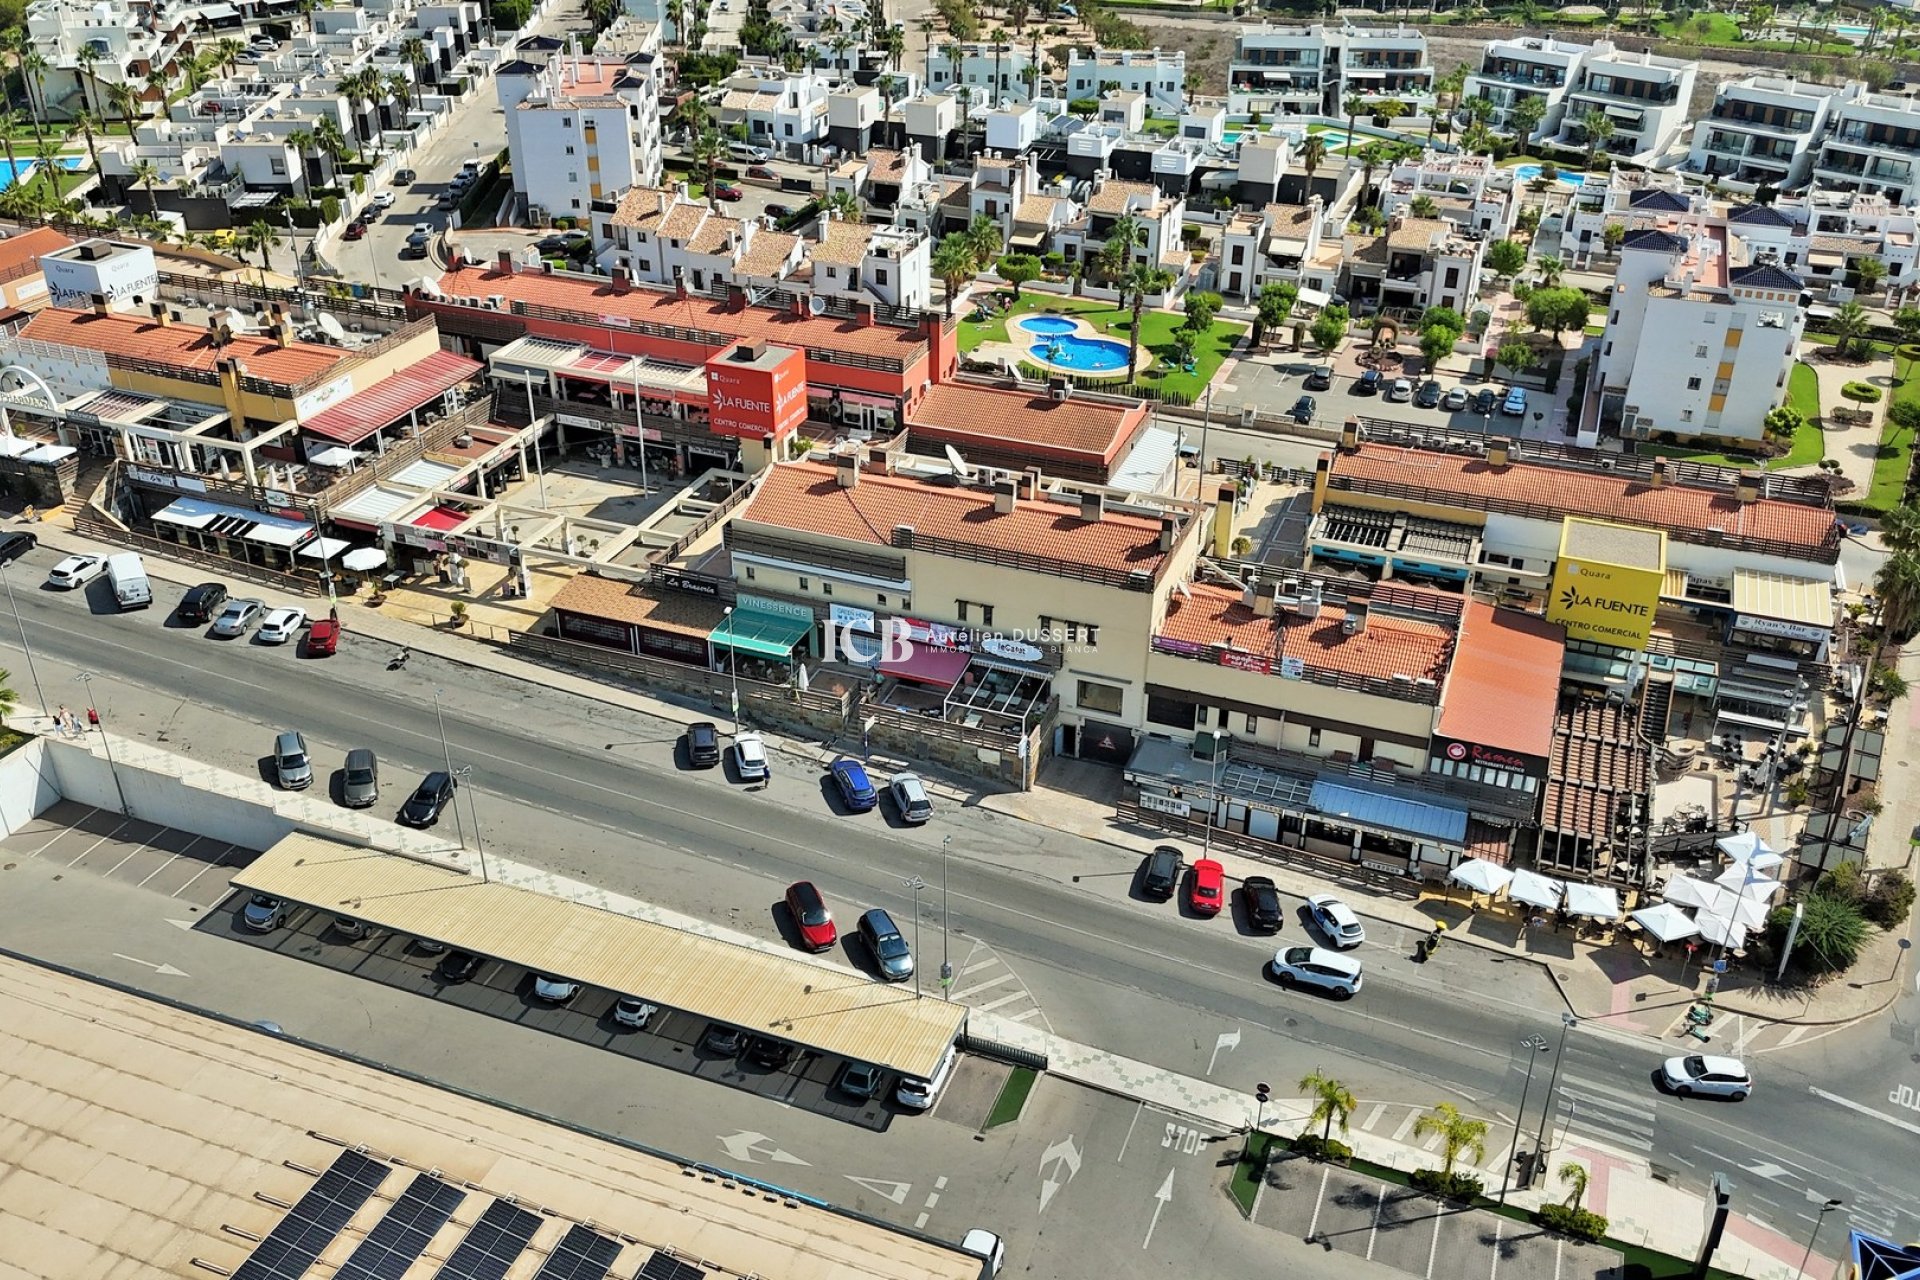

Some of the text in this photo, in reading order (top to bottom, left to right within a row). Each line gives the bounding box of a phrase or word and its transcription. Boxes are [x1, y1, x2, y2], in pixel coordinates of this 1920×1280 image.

[722, 397, 770, 413] LA FUENTE
[713, 418, 770, 433] CENTRO COMERCIAL
[1580, 568, 1611, 579] Quara
[743, 598, 807, 617] VINESSENCE
[1574, 594, 1649, 616] LA FUENTE
[1555, 618, 1642, 639] CENTRO COMERCIAL
[1471, 745, 1524, 767] Ramen
[1888, 1083, 1920, 1112] TOP
[1160, 1122, 1210, 1156] STOP
